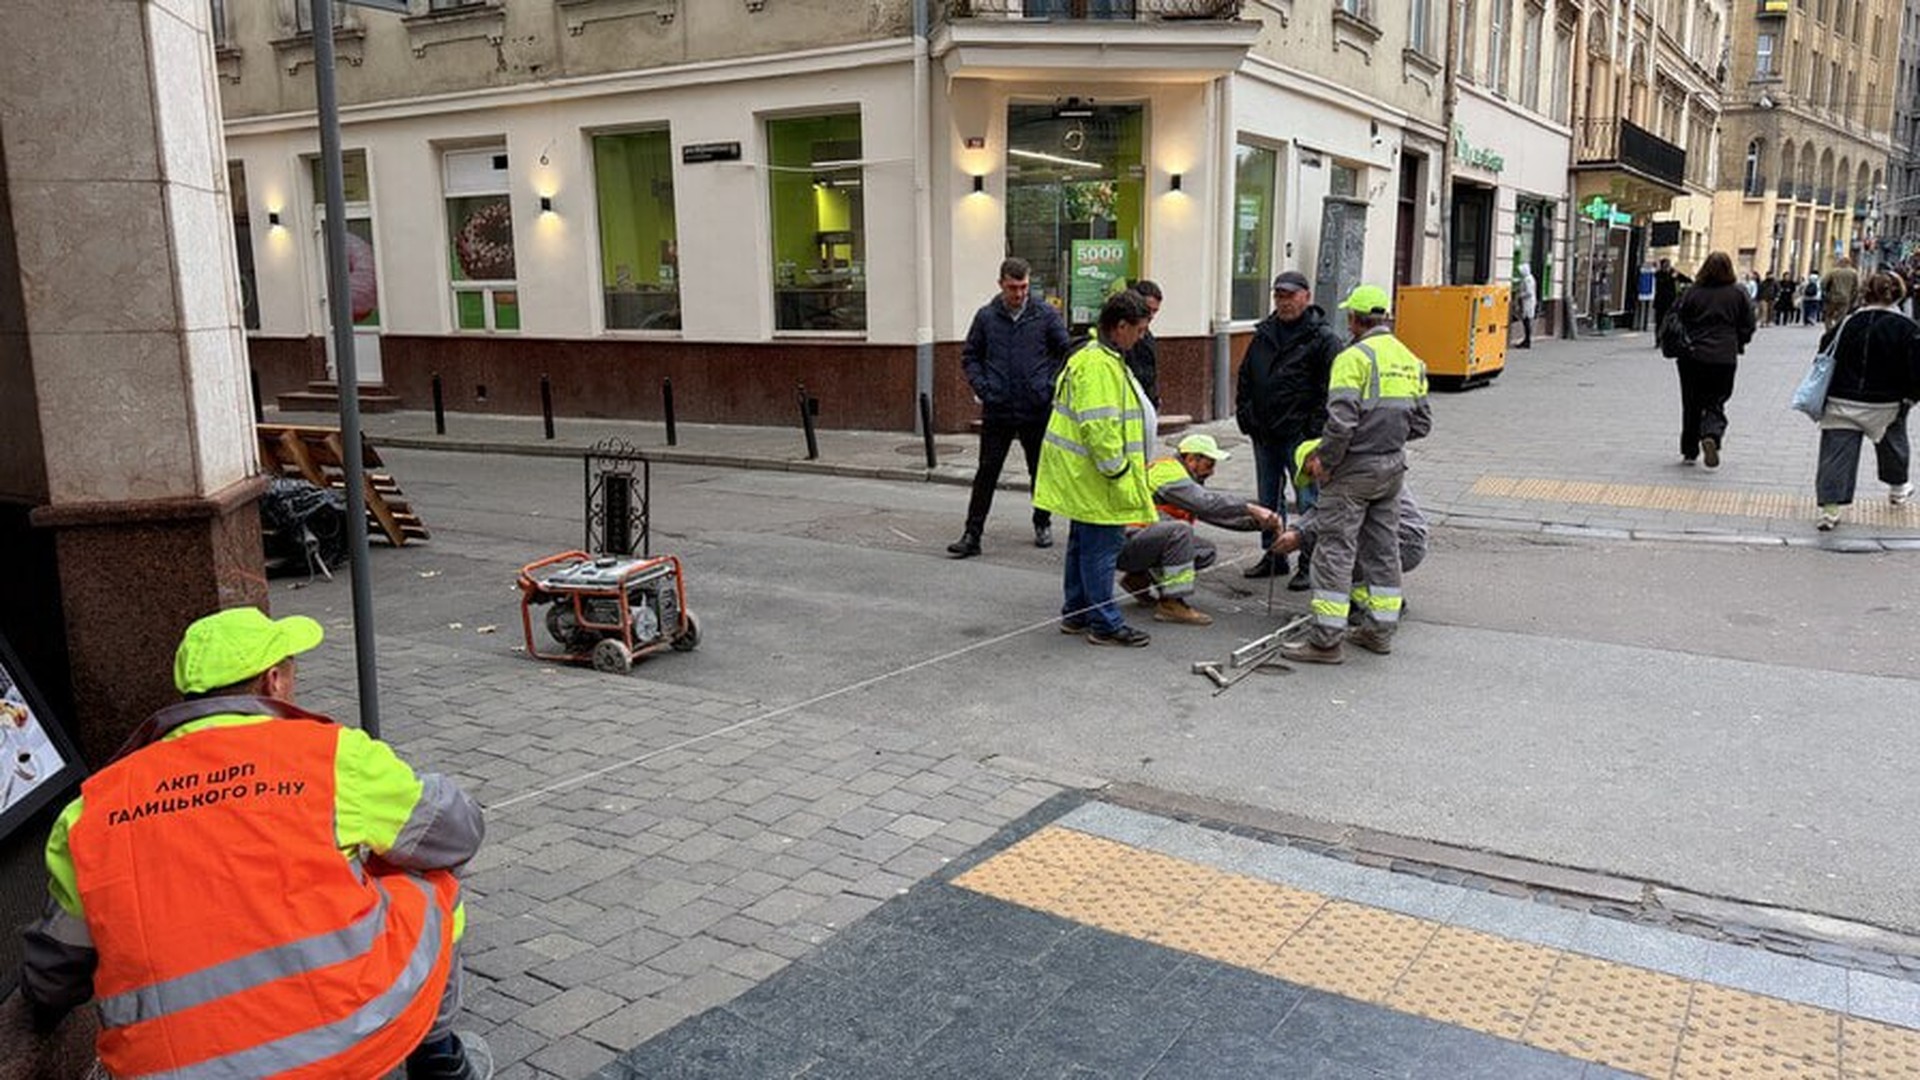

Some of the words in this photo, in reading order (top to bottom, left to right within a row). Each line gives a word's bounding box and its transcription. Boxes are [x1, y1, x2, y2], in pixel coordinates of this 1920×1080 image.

[1077, 247, 1124, 260] 5000
[155, 773, 199, 794] ЛКП
[206, 763, 256, 785] ШРП
[108, 785, 248, 826] ГАЛИЦЬКОГО
[254, 781, 305, 796] Р-НУ
